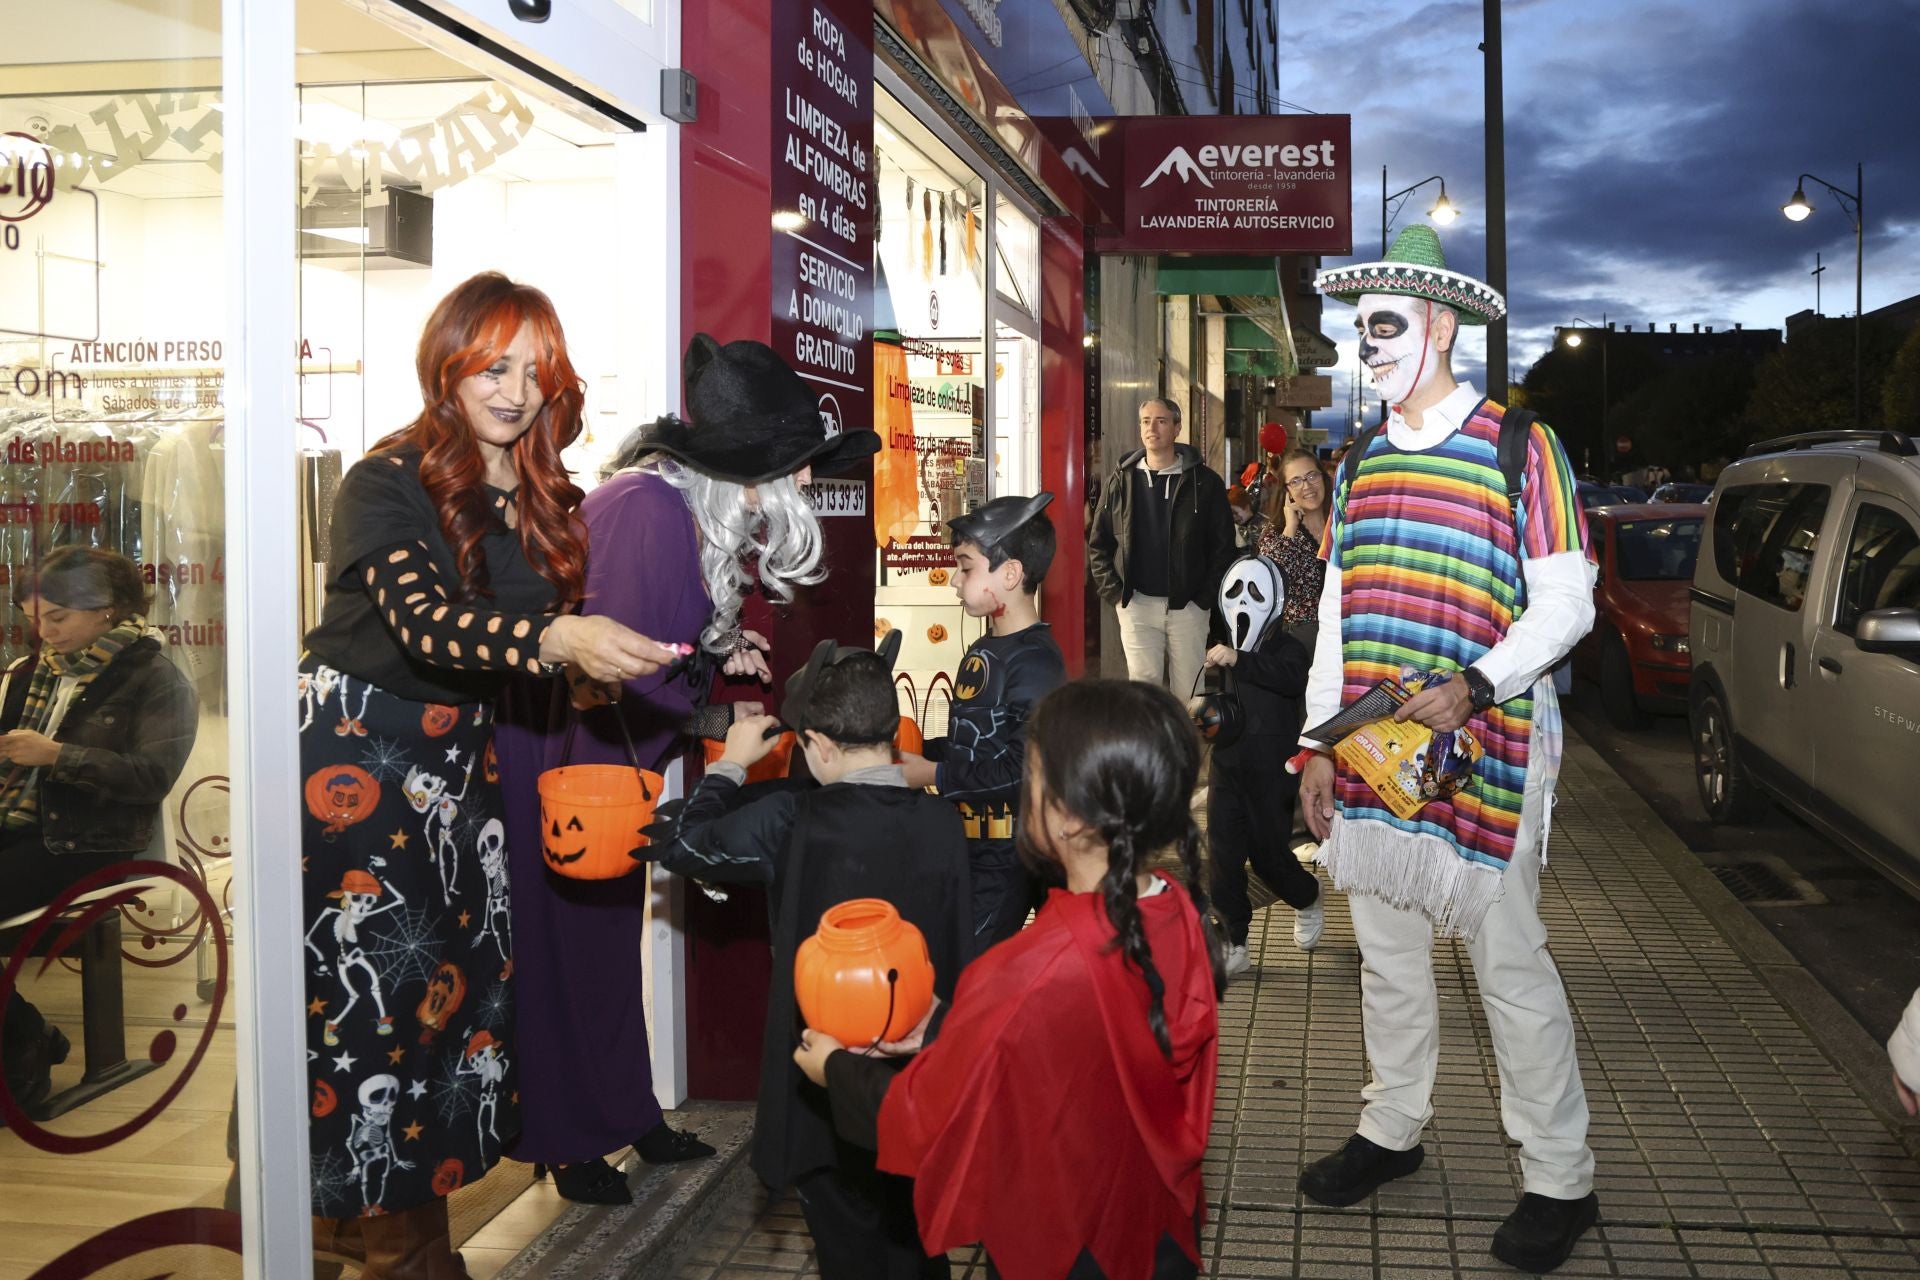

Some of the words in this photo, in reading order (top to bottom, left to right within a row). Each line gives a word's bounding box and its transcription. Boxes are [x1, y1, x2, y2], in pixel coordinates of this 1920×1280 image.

[813, 8, 845, 61] ROPA
[798, 37, 813, 71] de
[817, 51, 857, 108] HOGAR
[786, 87, 849, 161] LIMPIEZA
[852, 140, 866, 172] de
[1199, 140, 1335, 167] everest
[785, 133, 866, 210] ALFOMBRAS
[1210, 168, 1264, 181] tintorería
[1274, 168, 1335, 181] lavandería
[1248, 182, 1273, 190] desde
[1276, 182, 1296, 190] 1958
[799, 192, 815, 222] en
[820, 198, 828, 228] 4
[832, 204, 856, 243] días
[1195, 196, 1278, 212] TINTORERÍA
[1140, 213, 1229, 229] LAVANDERÍA
[1234, 215, 1335, 229] AUTOSERVICIO
[800, 252, 855, 302] SERVICIO
[788, 289, 799, 320] A
[803, 296, 863, 342] DOMICILIO
[71, 337, 158, 363] ATENCIÓN
[796, 331, 855, 375] GRATUITO
[93, 372, 125, 388] lunes
[889, 375, 925, 407] Limpieza
[927, 385, 936, 407] de
[8, 436, 34, 464] de
[41, 436, 134, 469] plancha
[889, 426, 925, 457] Limpieza
[826, 484, 836, 510] 13
[839, 484, 850, 510] 39
[853, 485, 863, 510] 39
[913, 541, 924, 550] del
[176, 562, 205, 585] en
